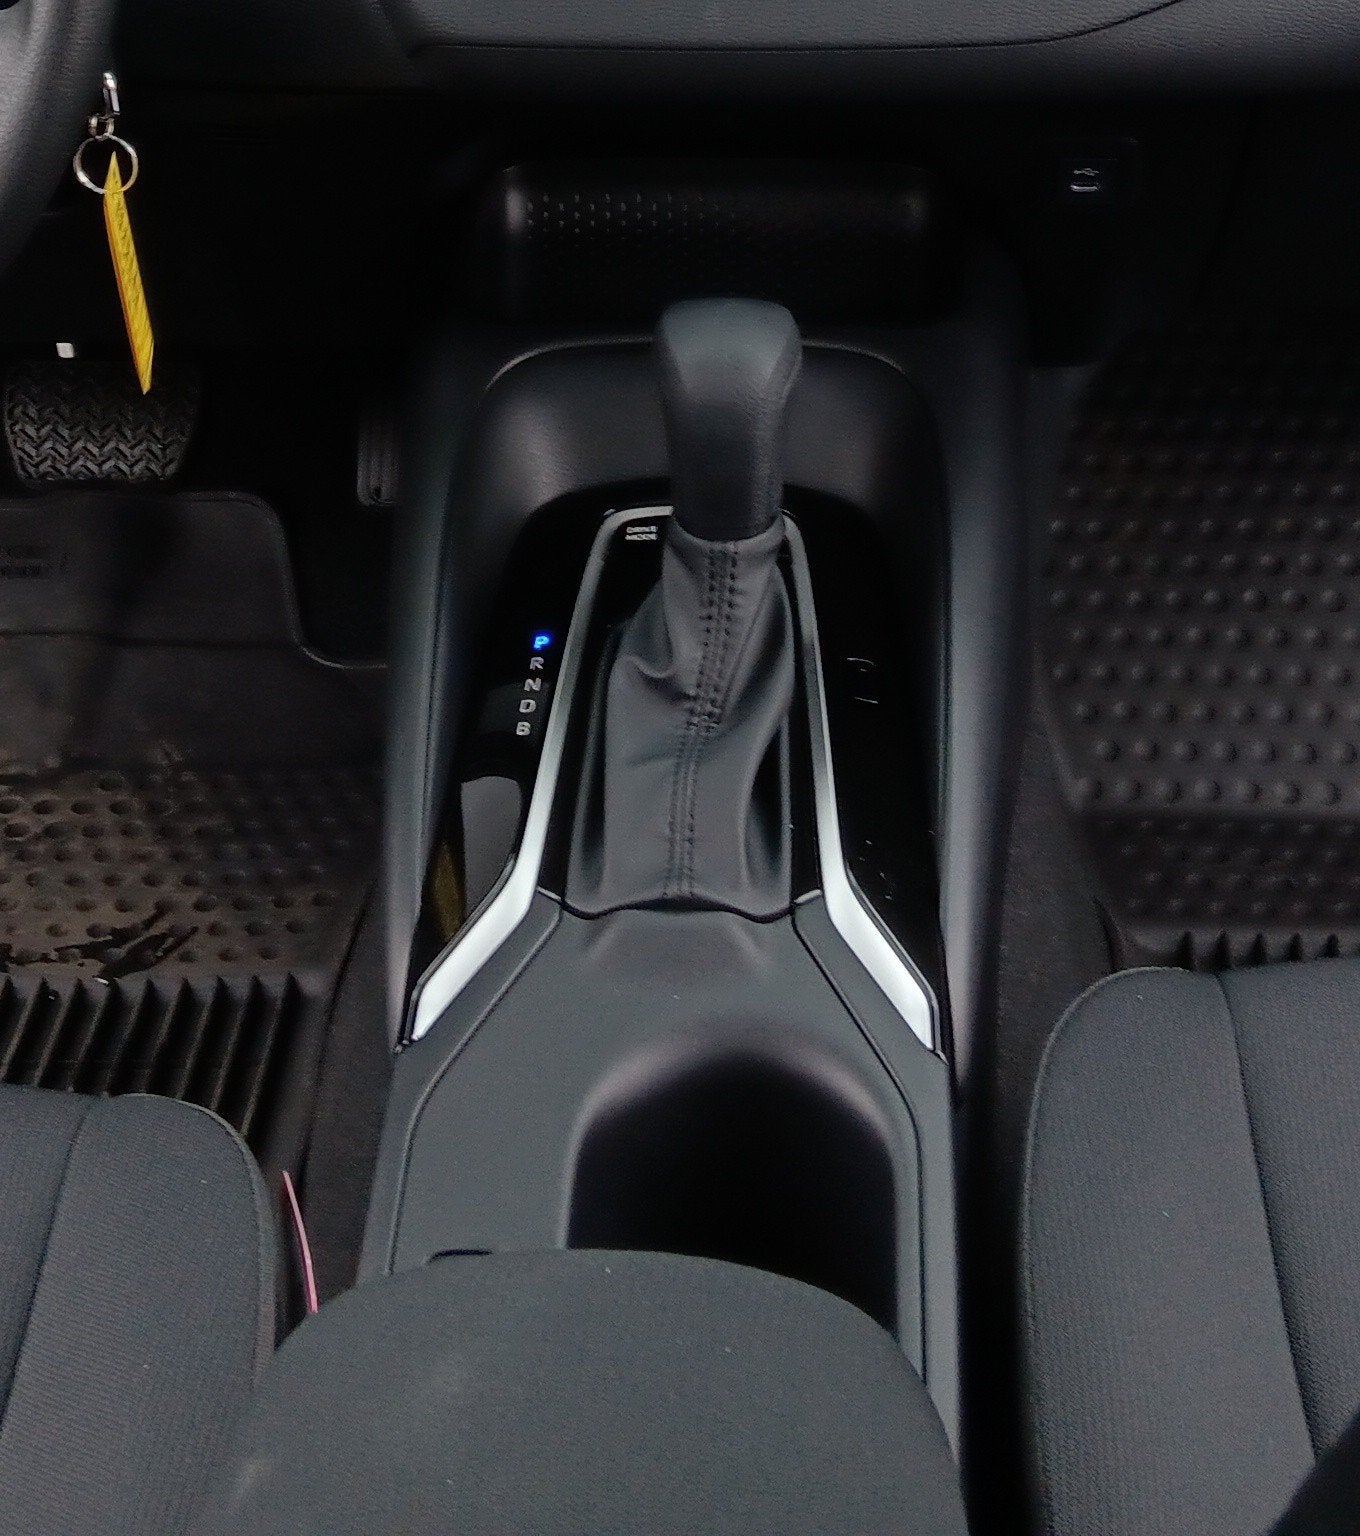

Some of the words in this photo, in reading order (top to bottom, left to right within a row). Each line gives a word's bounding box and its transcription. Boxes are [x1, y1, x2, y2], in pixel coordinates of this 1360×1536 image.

[534, 635, 549, 649] P
[530, 657, 544, 670] R
[524, 677, 542, 691] N
[519, 699, 536, 713] D
[516, 721, 531, 736] B
